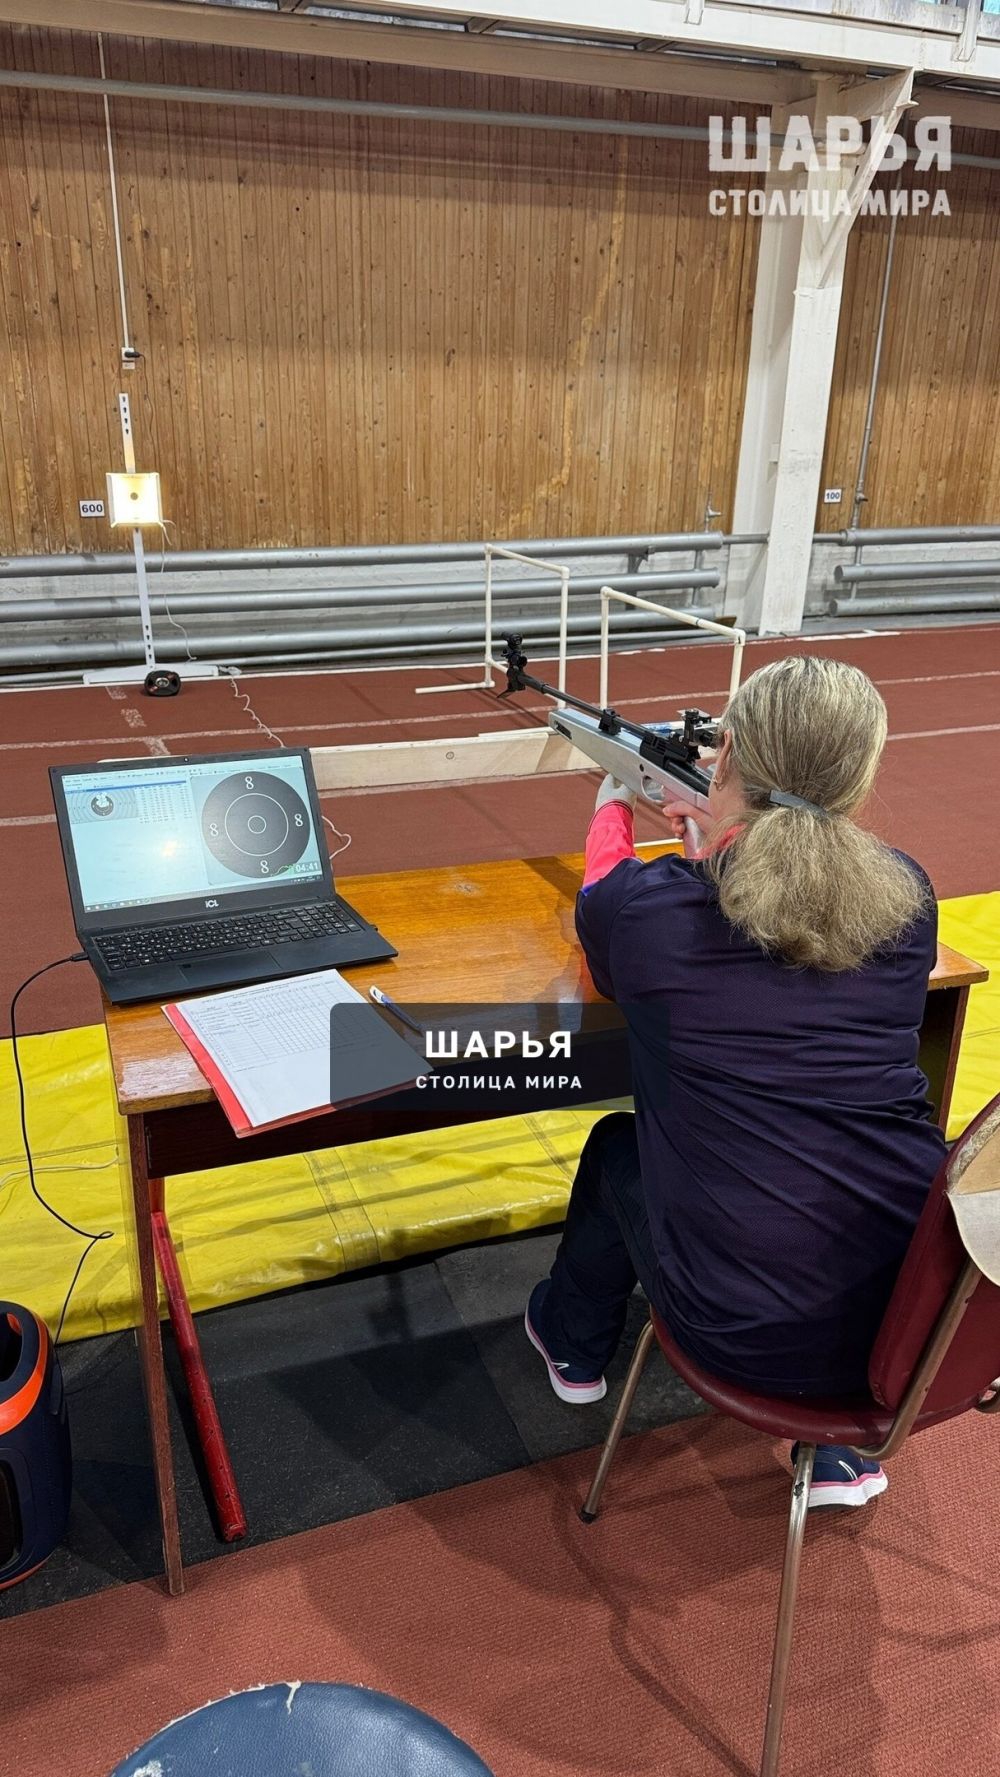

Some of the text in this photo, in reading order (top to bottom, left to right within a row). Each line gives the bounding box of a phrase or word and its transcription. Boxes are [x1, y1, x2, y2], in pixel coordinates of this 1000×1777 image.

[826, 492, 840, 500] 100
[81, 504, 103, 513] 600
[244, 776, 254, 790] 8
[294, 814, 304, 827] 8
[209, 824, 219, 837] 8
[260, 860, 269, 874] 8
[295, 862, 319, 873] 04:41
